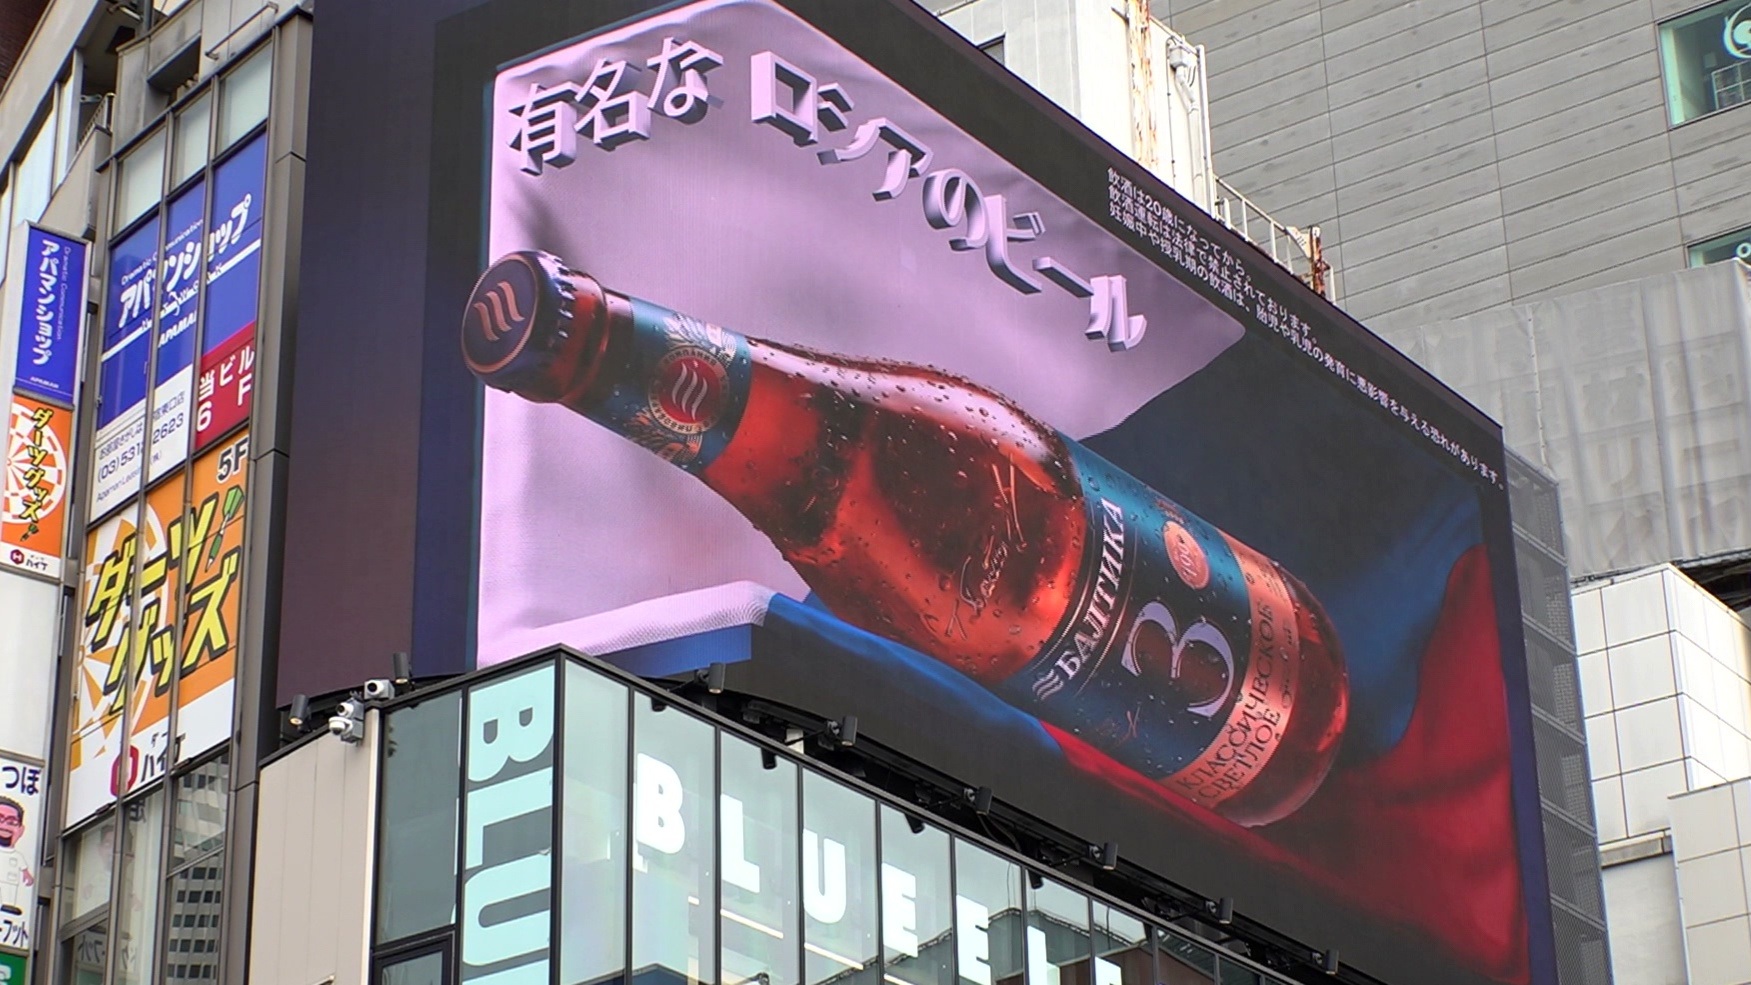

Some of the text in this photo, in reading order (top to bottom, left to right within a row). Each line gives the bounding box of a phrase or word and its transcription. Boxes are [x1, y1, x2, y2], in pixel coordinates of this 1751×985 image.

[508, 37, 1147, 352] 有名な ロシアのビール
[32, 239, 60, 366] アパマンショップ
[199, 345, 255, 401] 当ビル
[19, 407, 54, 523] ダーツグッズ
[217, 435, 249, 482] 5F
[85, 492, 219, 653] ダーツ
[1055, 498, 1124, 680] БАЛТИКА
[1121, 601, 1234, 717] 3
[2, 766, 41, 796] つぼ
